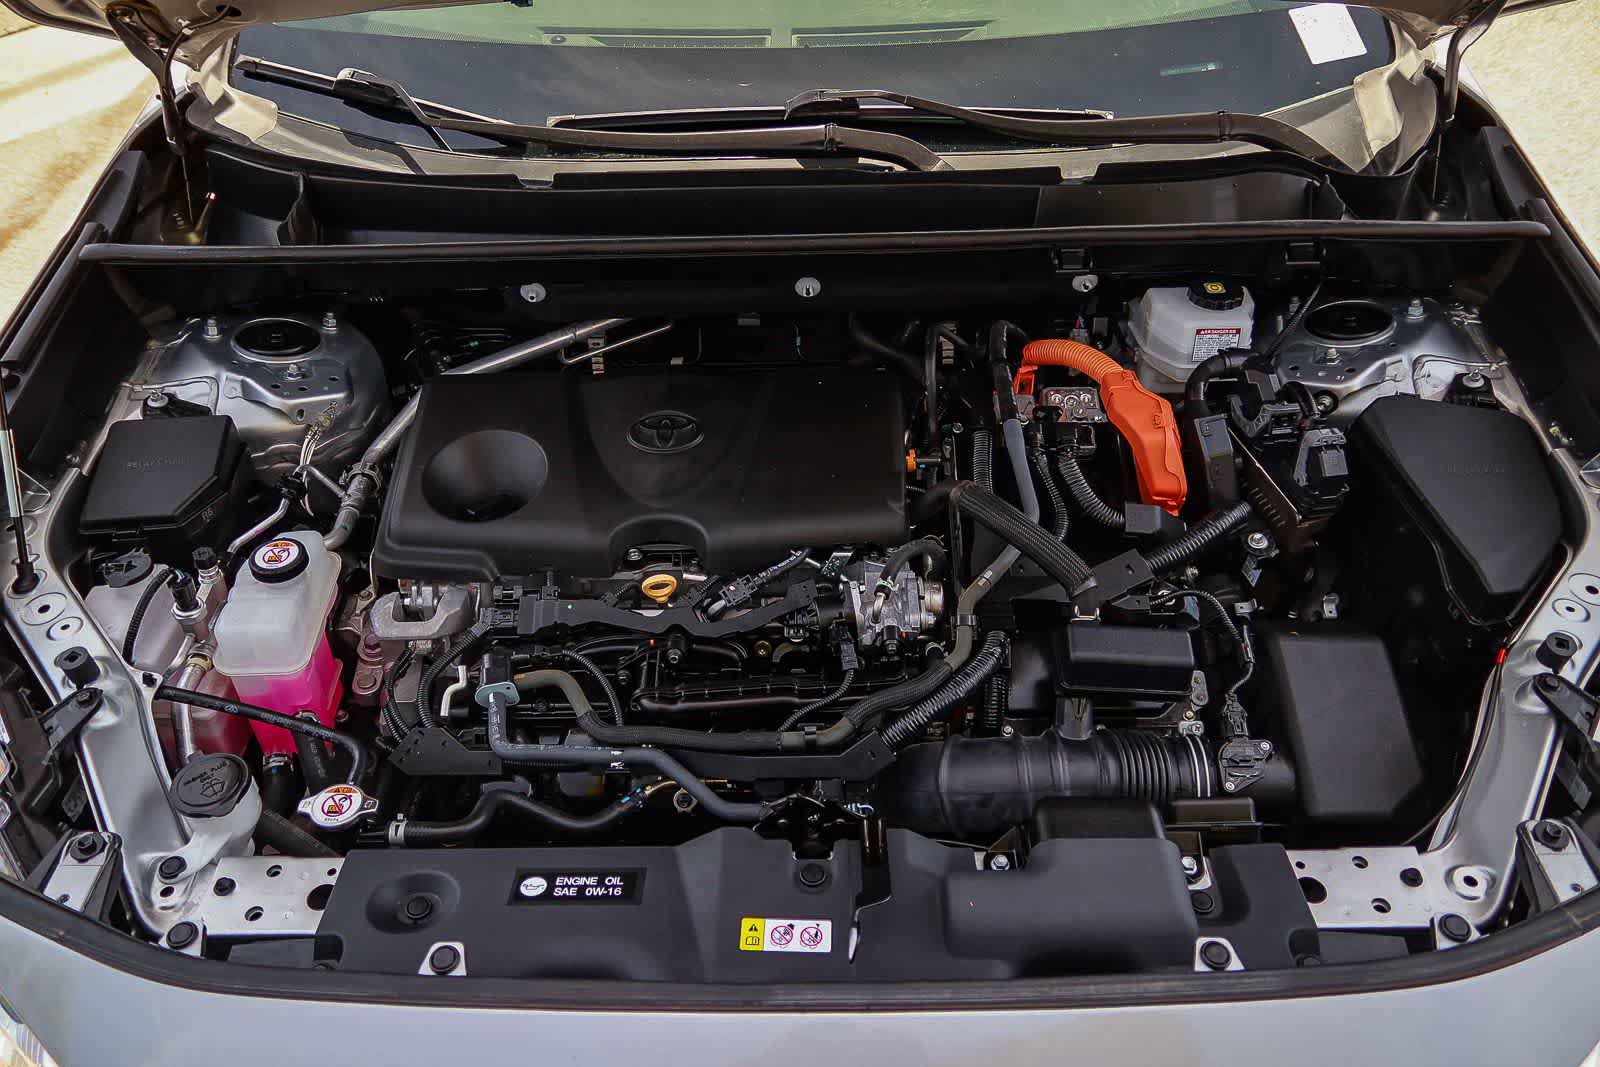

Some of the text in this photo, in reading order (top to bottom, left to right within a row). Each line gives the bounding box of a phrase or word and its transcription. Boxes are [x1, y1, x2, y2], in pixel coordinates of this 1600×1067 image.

[555, 876, 624, 886] ENGINE OIL
[553, 887, 622, 896] SAE 0W-16
